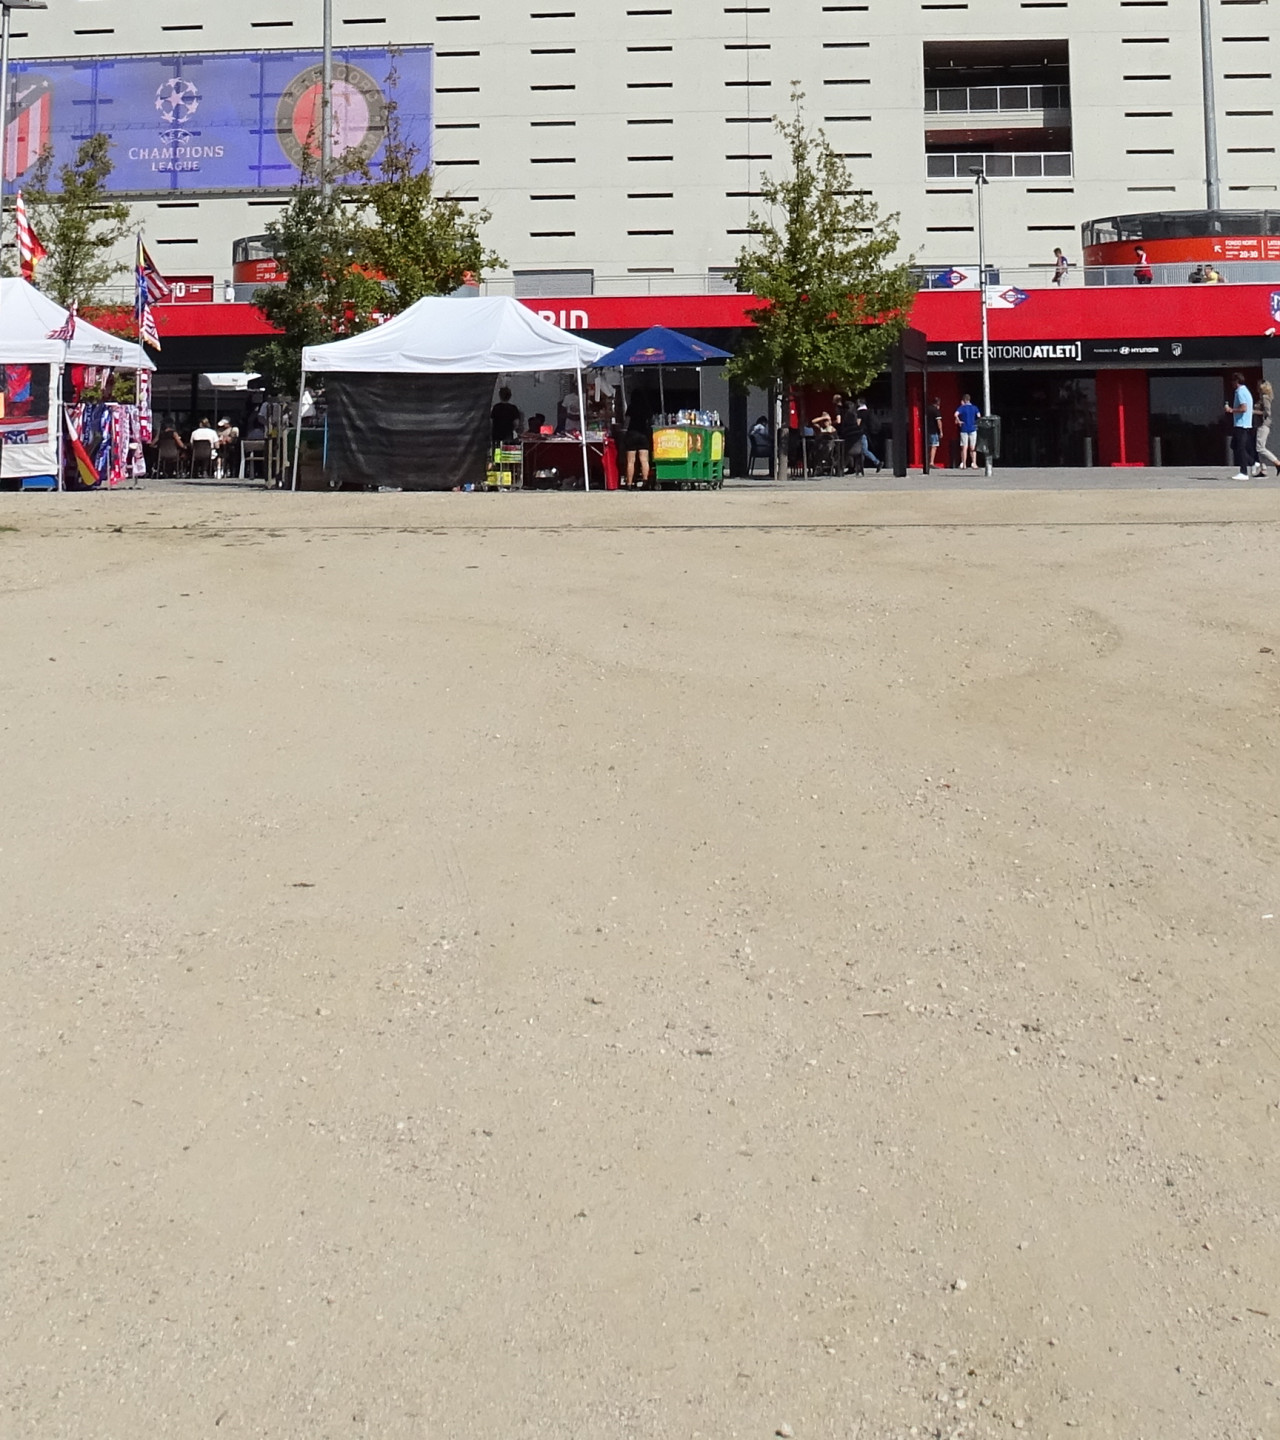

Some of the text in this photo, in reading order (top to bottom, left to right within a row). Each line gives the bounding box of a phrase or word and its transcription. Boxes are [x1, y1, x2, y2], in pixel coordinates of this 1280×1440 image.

[160, 131, 191, 145] UEFA
[128, 146, 224, 160] CHAMPIONS
[151, 162, 200, 172] LEAGUE
